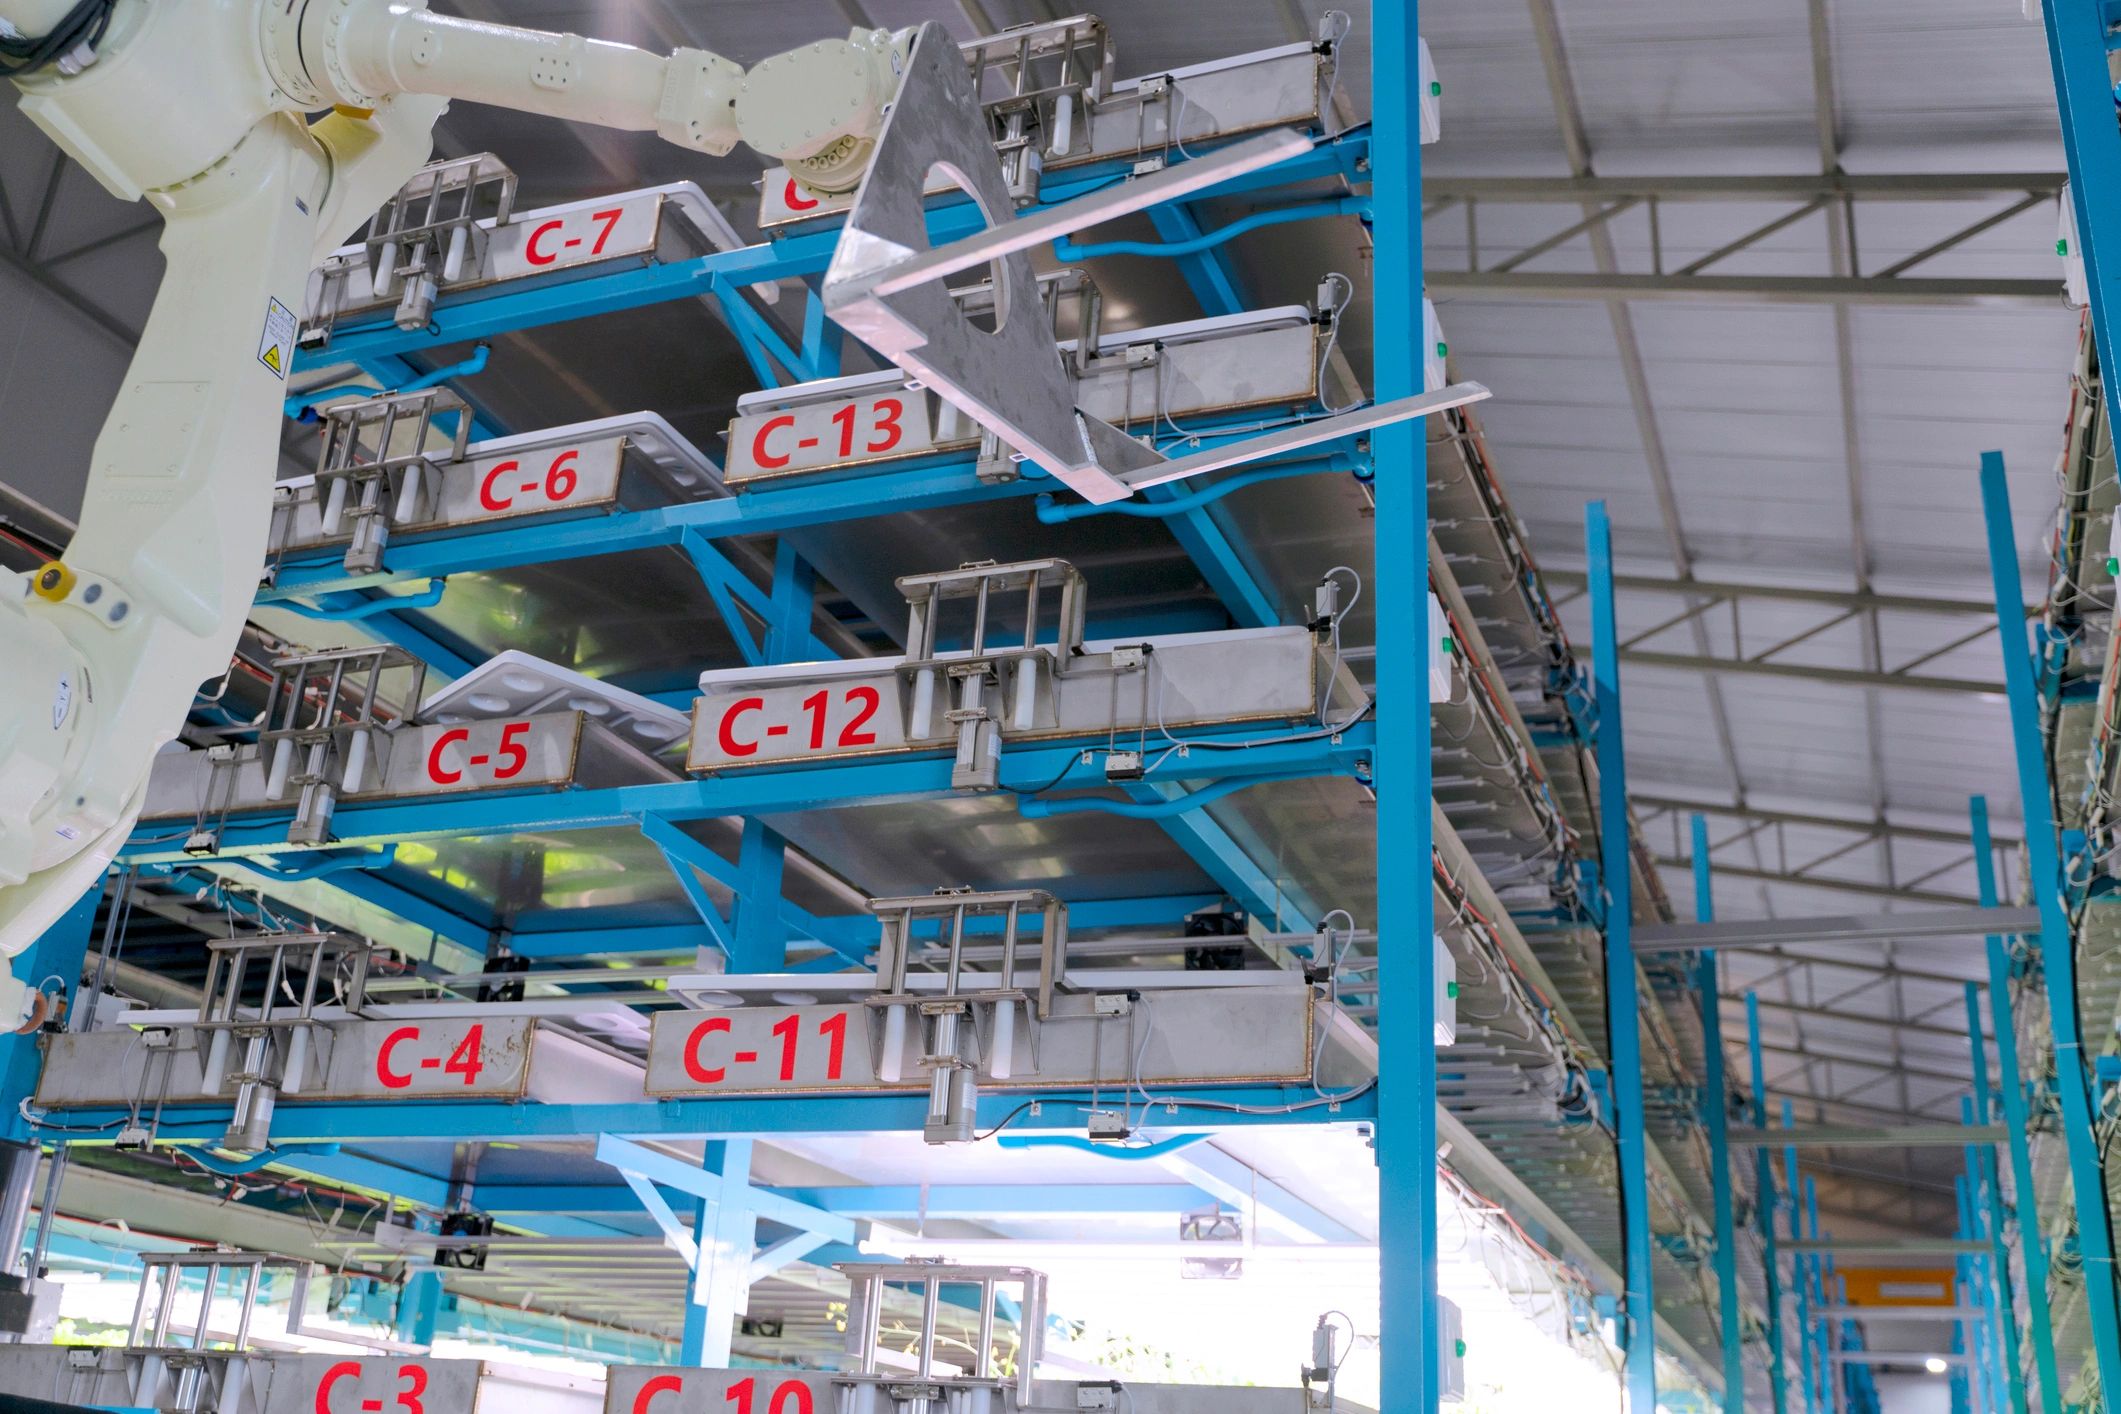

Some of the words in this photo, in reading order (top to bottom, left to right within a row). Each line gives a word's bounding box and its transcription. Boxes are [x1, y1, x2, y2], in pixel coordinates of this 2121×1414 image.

[526, 209, 623, 266] C-7
[753, 399, 903, 469] C-13
[480, 451, 579, 511] C-6
[428, 722, 530, 785] C-5
[719, 687, 880, 757] C-12
[377, 1024, 484, 1089] C-4
[684, 1013, 846, 1083] C-11
[315, 1361, 428, 1414] C-3
